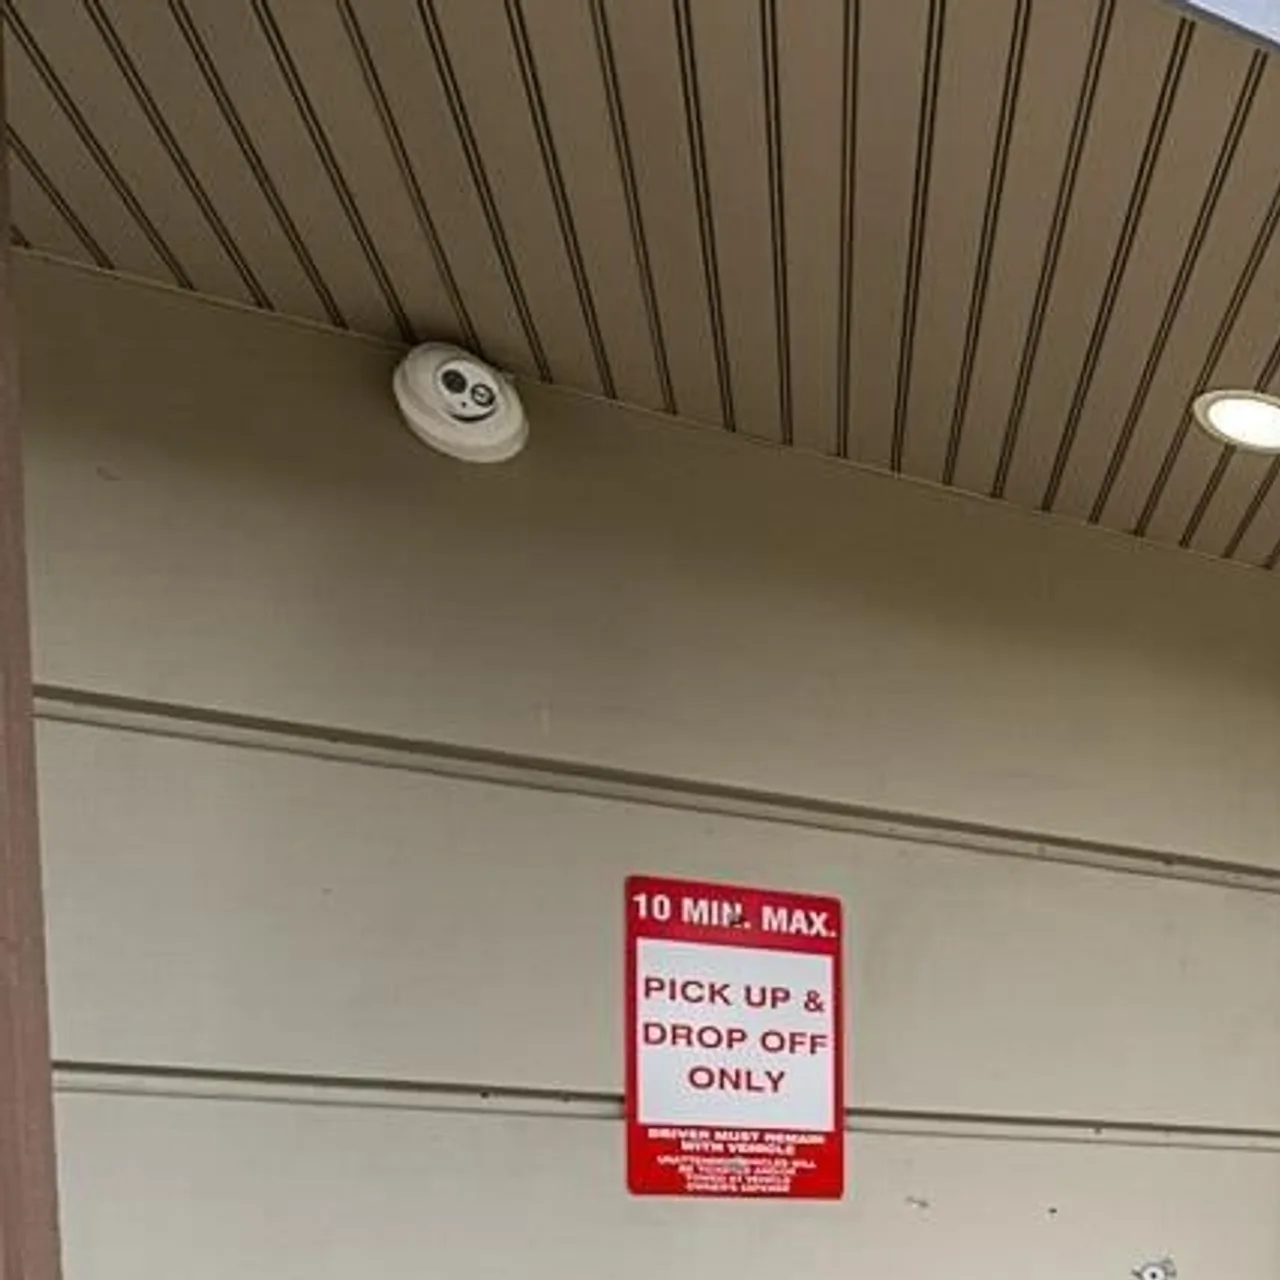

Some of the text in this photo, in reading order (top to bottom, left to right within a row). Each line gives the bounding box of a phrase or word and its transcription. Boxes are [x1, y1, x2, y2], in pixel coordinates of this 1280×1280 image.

[633, 893, 837, 938] 10 MIN. MAX.
[644, 976, 825, 1013] PICK UP &
[643, 1022, 828, 1056] DROP OFF
[688, 1066, 785, 1092] ONLY
[714, 1131, 760, 1143] MUST
